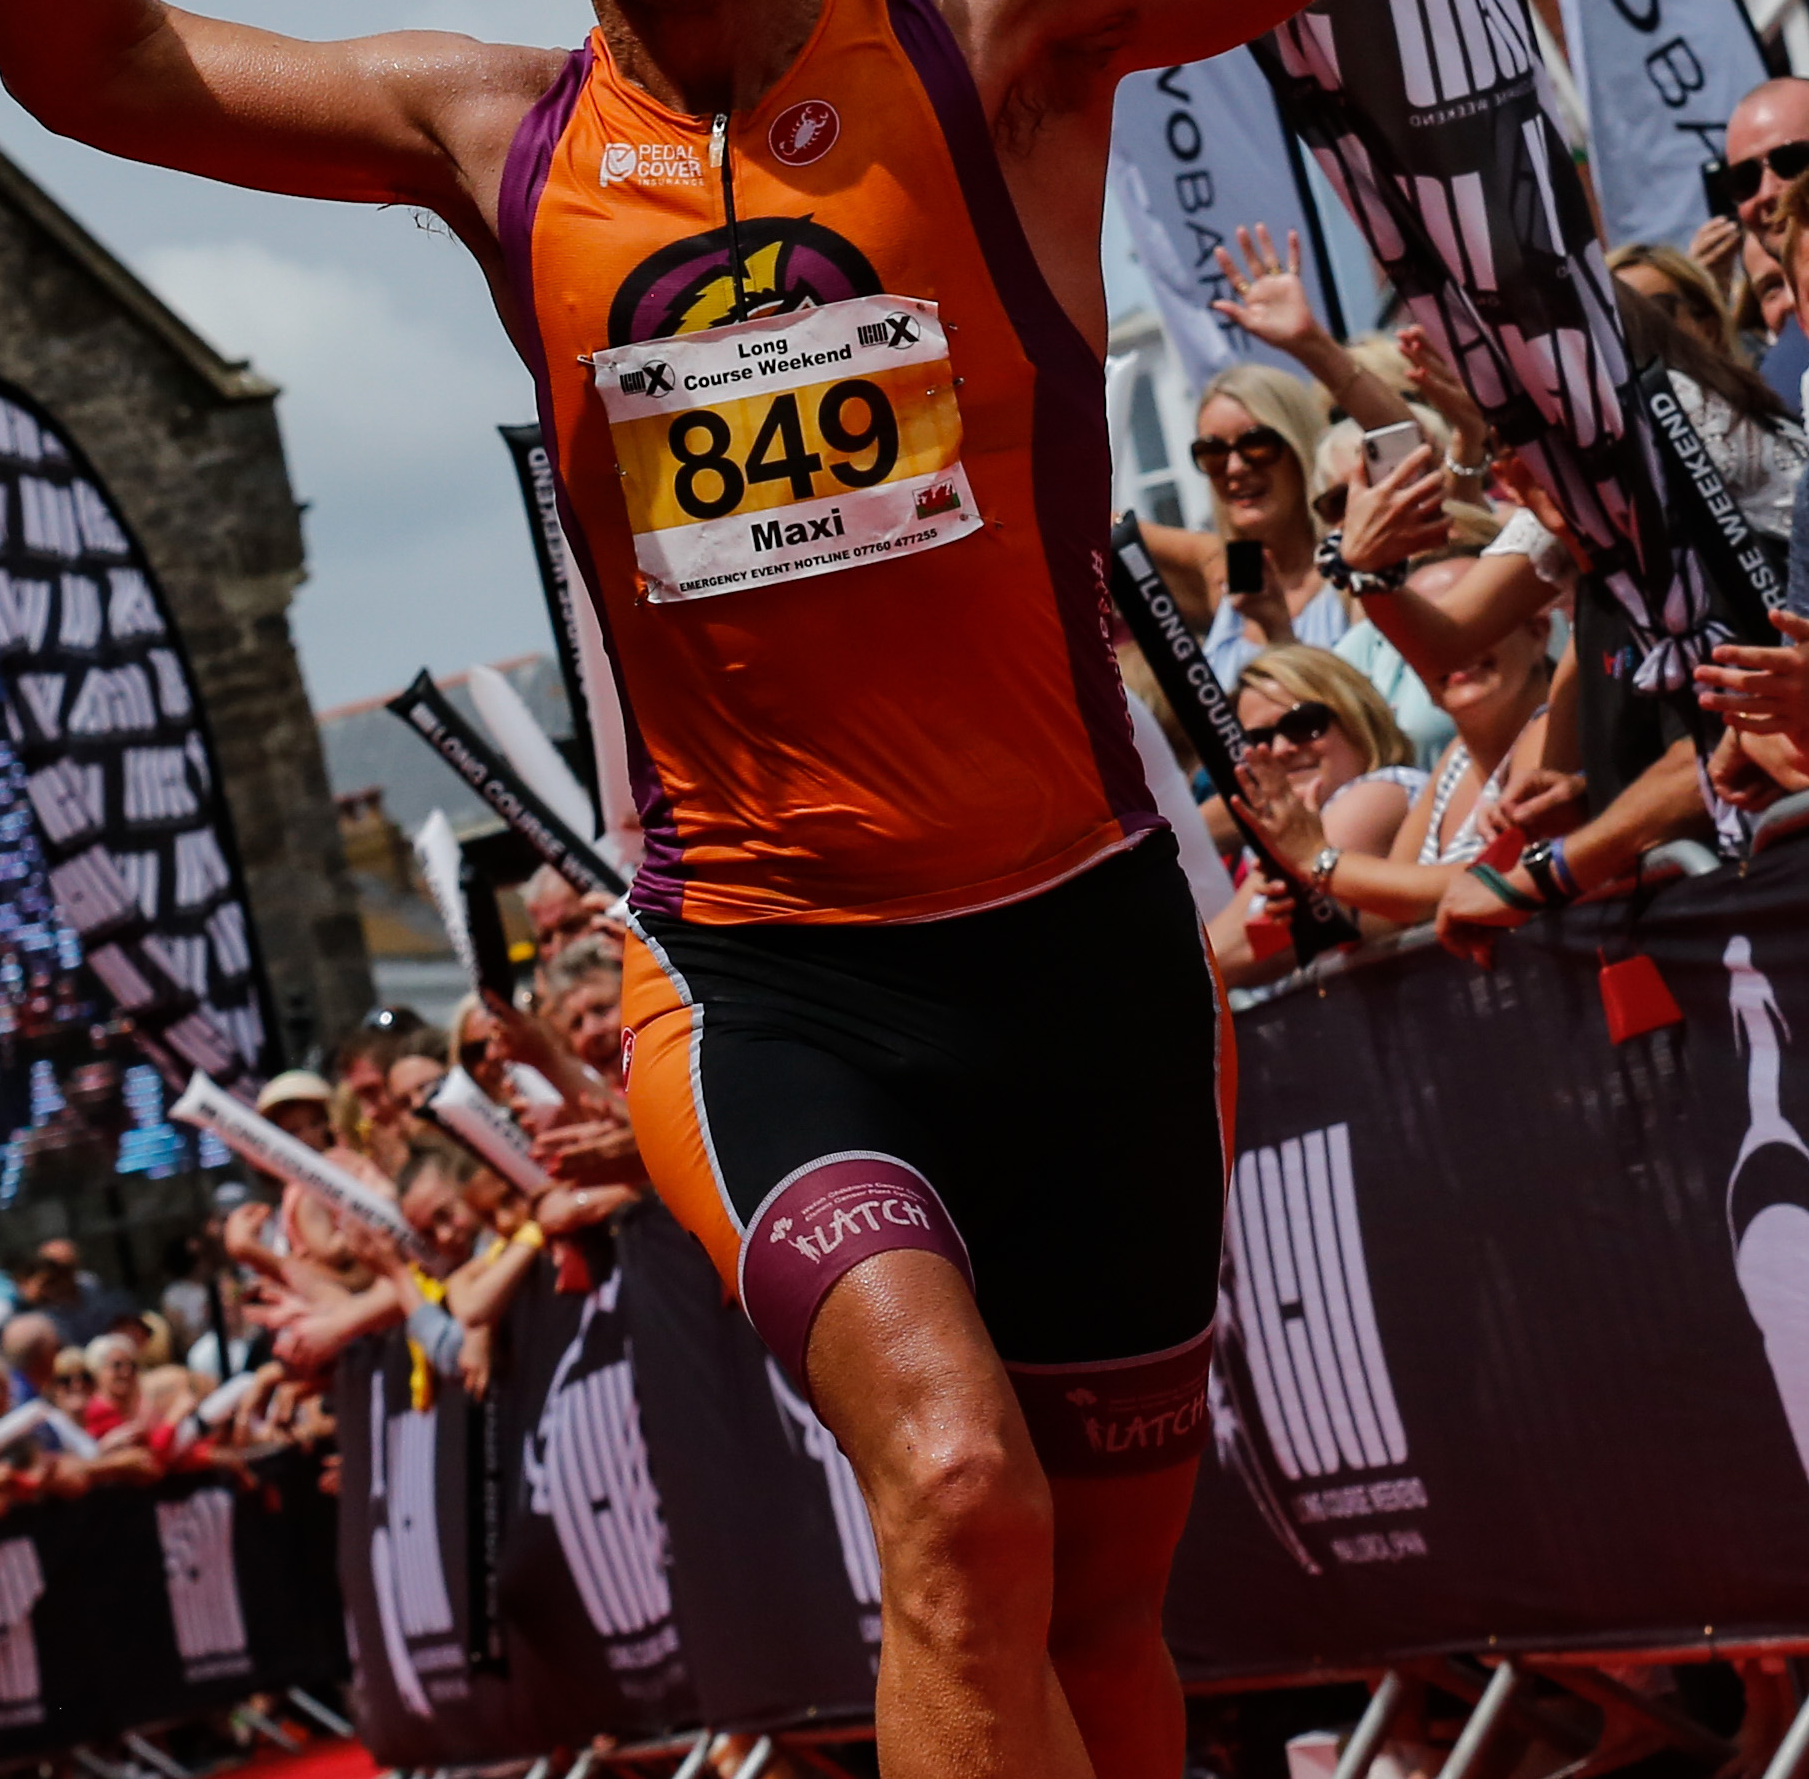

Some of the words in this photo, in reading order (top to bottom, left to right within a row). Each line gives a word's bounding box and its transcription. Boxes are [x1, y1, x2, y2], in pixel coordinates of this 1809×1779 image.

[637, 159, 703, 178] COVER
[638, 143, 700, 161] PEDAL
[683, 365, 754, 392] Course
[757, 344, 853, 377] Weekend
[737, 338, 789, 360] Long
[667, 378, 901, 521] 849
[1649, 391, 1749, 547] WEEKEND
[749, 507, 847, 553] Maxi
[679, 571, 748, 593] EMERGENCY
[750, 562, 792, 580] EVENT
[793, 549, 851, 571] HOTLINE
[853, 540, 892, 558] 07760
[893, 528, 939, 550] 477255
[1140, 575, 1196, 662] LONG
[1186, 660, 1255, 769] COURS
[813, 1197, 931, 1255] LATCH
